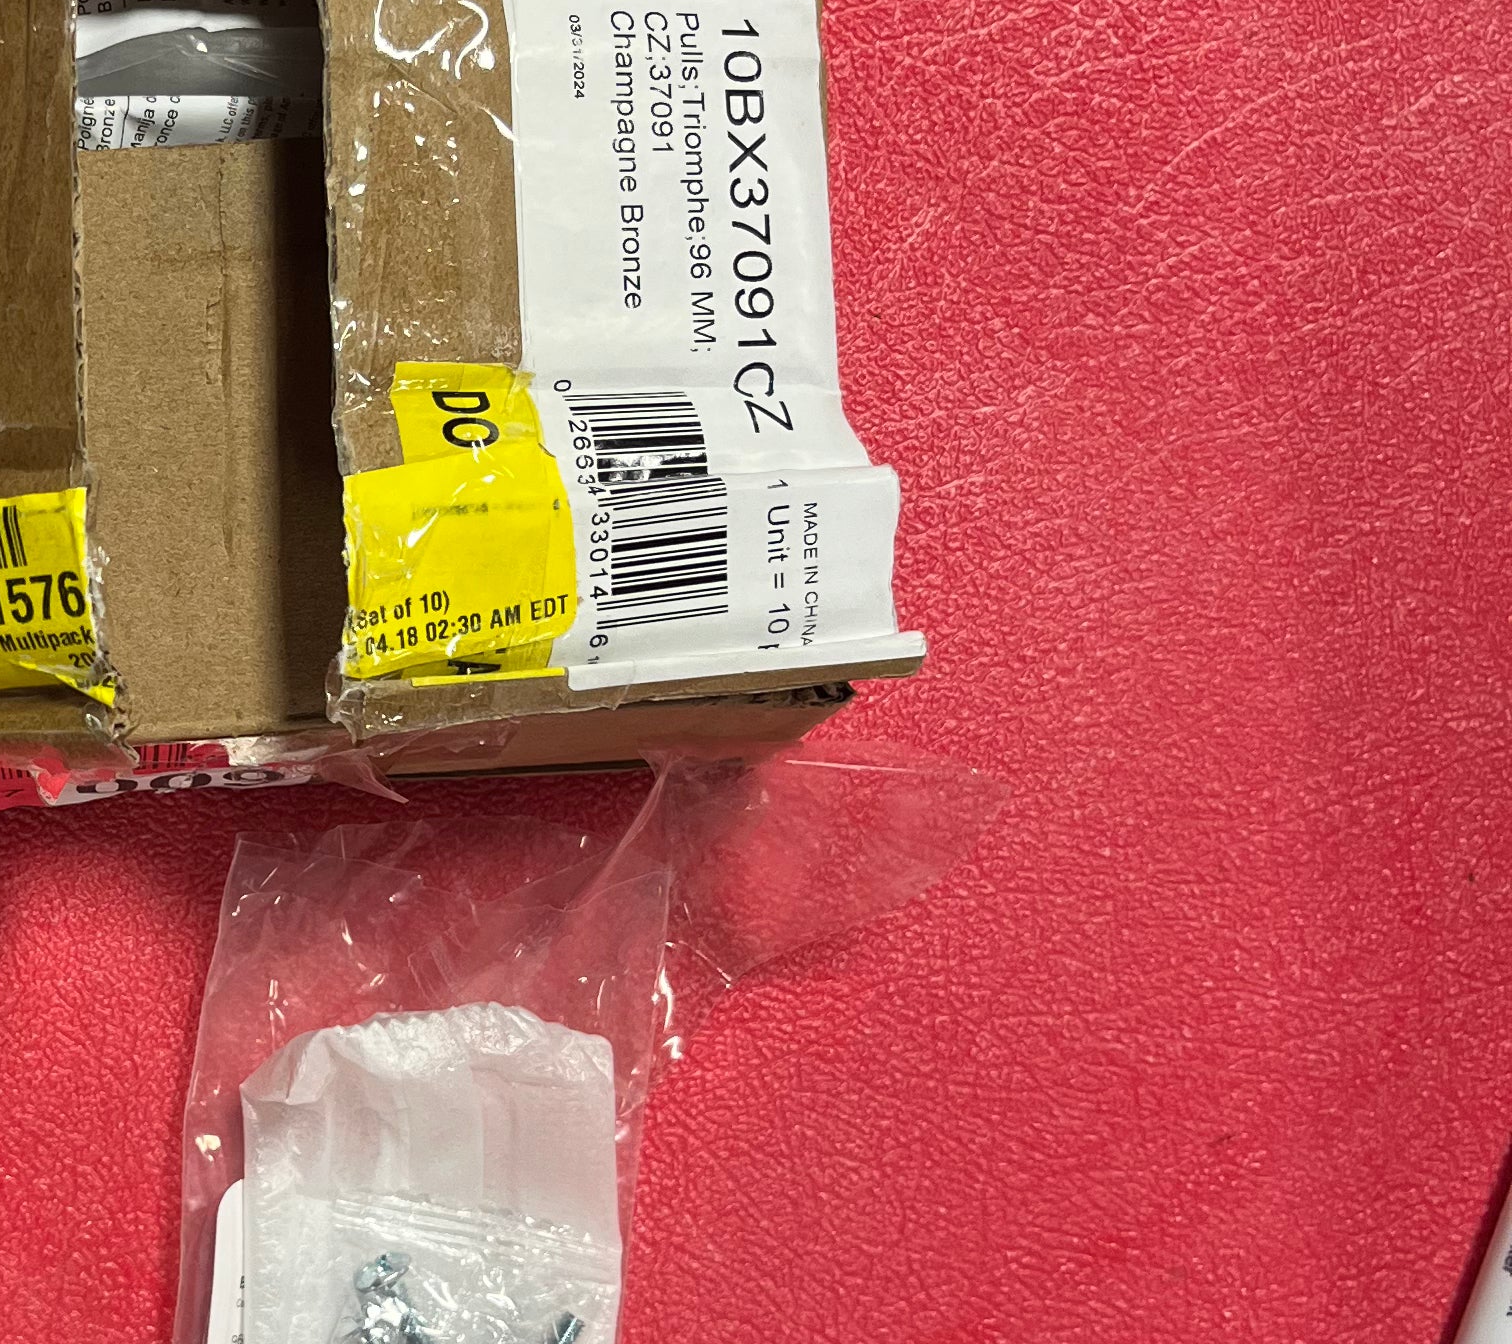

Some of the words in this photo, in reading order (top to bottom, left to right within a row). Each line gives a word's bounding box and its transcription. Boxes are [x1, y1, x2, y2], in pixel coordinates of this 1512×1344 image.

[568, 13, 586, 100] 03/31/2024
[643, 11, 675, 153] CZ;37091
[609, 9, 637, 193] Champagne
[675, 12, 712, 280] Pulls;Triomphe;96
[721, 18, 794, 434] 10BX37091CZ
[620, 204, 644, 310] Bronze
[689, 291, 717, 353] MM;
[767, 478, 789, 490] 1
[589, 511, 611, 600] 33014
[767, 504, 791, 564] Unit
[803, 502, 818, 560] MADE
[393, 597, 412, 621] of
[419, 590, 450, 616] 10)
[804, 565, 819, 585] IN
[425, 613, 482, 642] 02:30
[490, 604, 521, 629] AM
[530, 594, 569, 621] EDT
[767, 603, 791, 635] 10
[800, 590, 819, 647] CHINA
